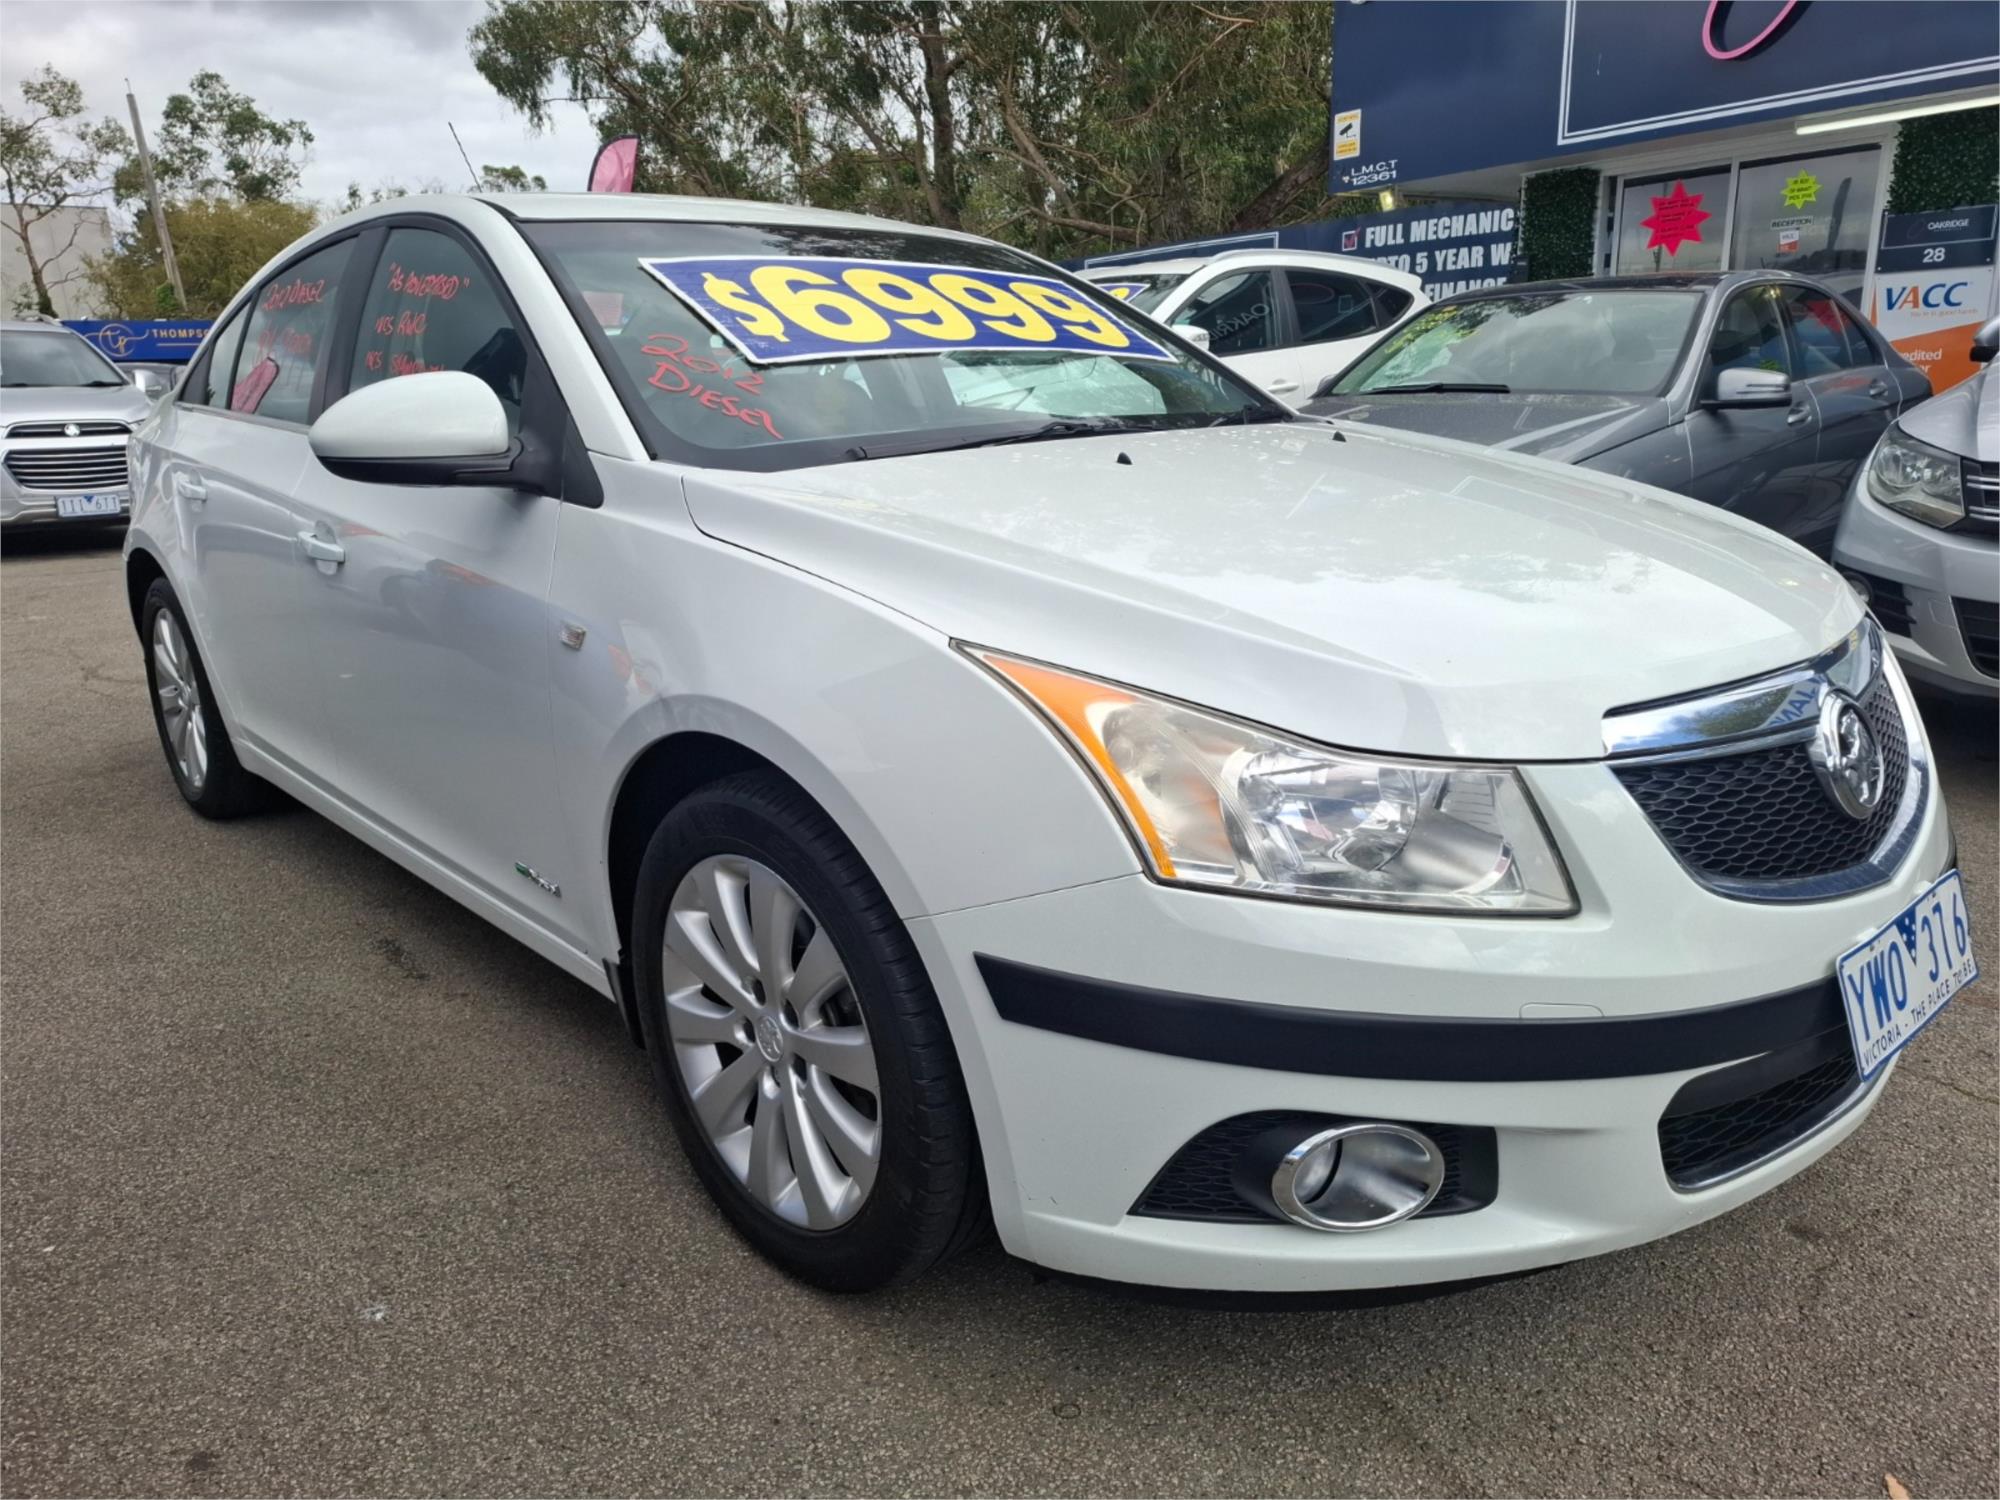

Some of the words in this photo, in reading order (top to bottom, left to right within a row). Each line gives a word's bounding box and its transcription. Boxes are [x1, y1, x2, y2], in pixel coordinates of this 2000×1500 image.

[1349, 170, 1397, 186] 12361
[1364, 223, 1404, 248] FULL
[1409, 208, 1515, 243] MECHANIC
[1927, 218, 1969, 230] OAKRIDGE
[1369, 253, 1411, 273] TO
[1415, 252, 1428, 274] 5
[1434, 246, 1484, 272] YEAR
[1922, 247, 1945, 264] 28
[701, 265, 1131, 347] $6999
[1885, 281, 1968, 311] VACC
[640, 333, 764, 395] 2012
[1847, 941, 1907, 1041] YWO
[1921, 893, 1967, 983] 376
[1863, 1024, 1902, 1066] VICTORIA
[1911, 1001, 1927, 1023] THE
[1928, 979, 1950, 1012] PLACE
